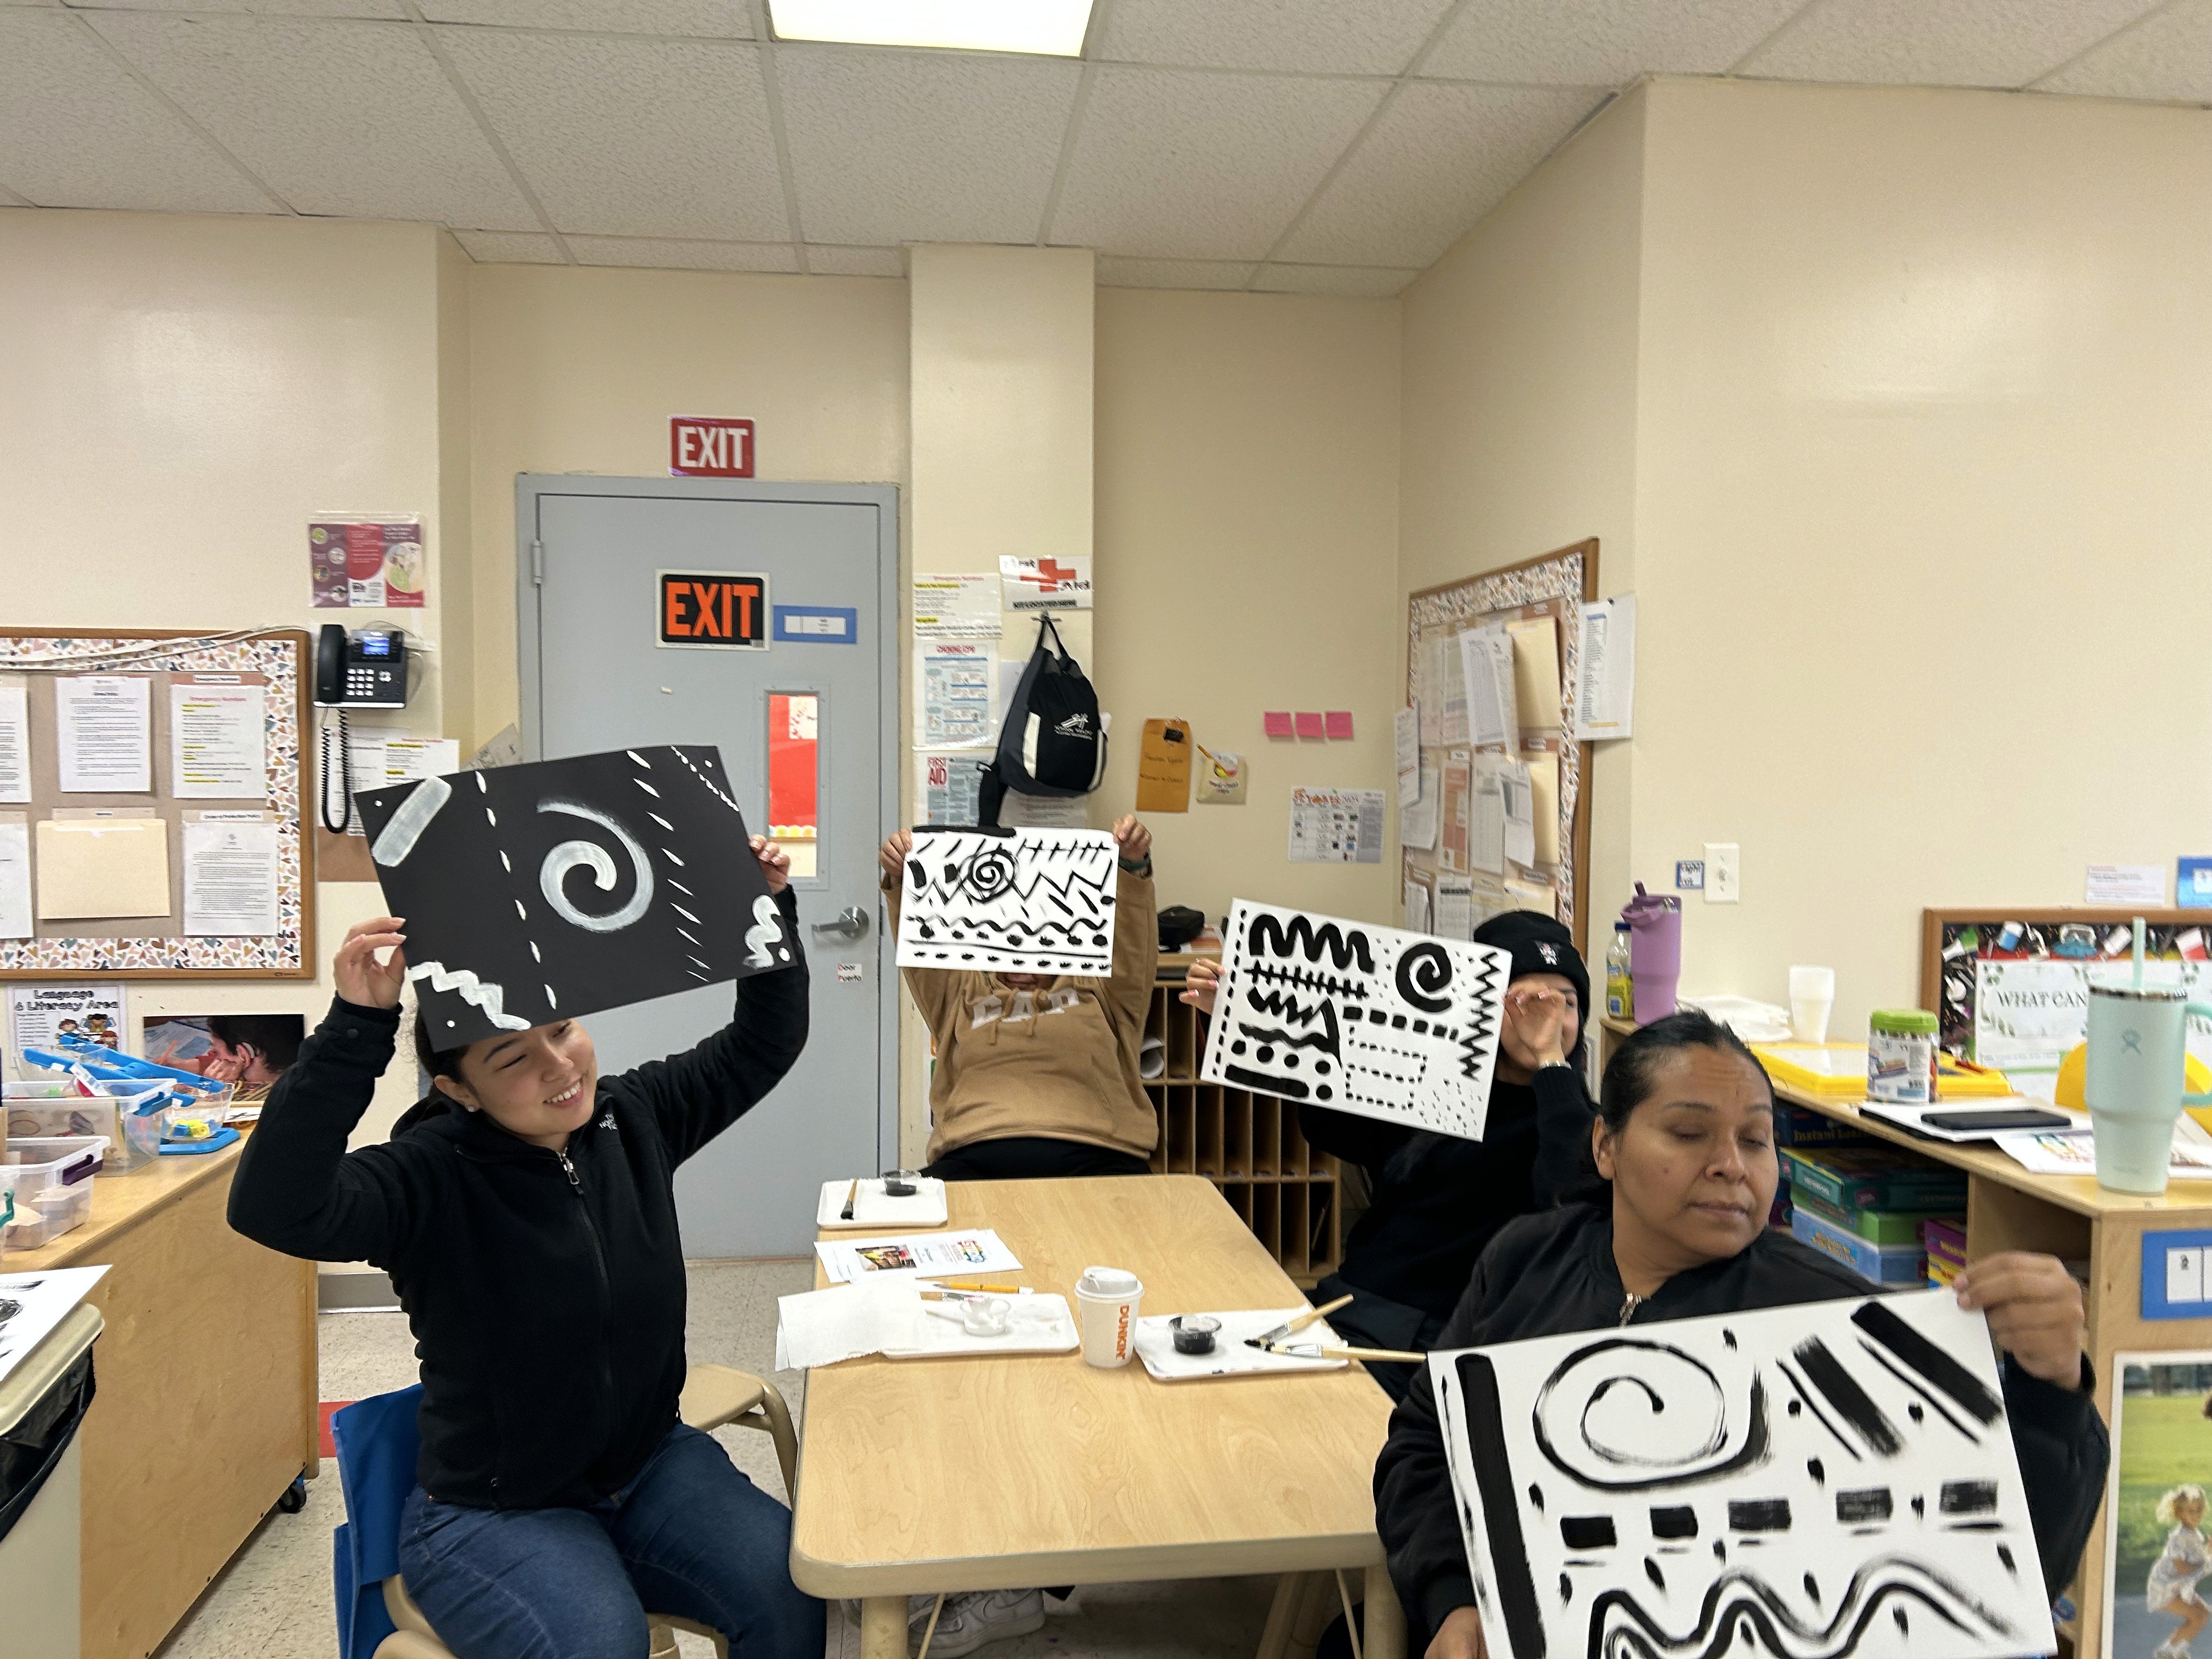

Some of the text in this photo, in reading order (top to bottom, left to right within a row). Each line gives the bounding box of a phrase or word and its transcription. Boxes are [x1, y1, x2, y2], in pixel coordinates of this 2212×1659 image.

[678, 426, 748, 470] EXIT
[665, 581, 759, 639] EXIT
[927, 768, 947, 785] AID
[33, 990, 94, 1000] Language
[1996, 991, 2087, 1008] WHAT CAN
[26, 1001, 83, 1012] Literacy
[86, 1000, 119, 1009] Area
